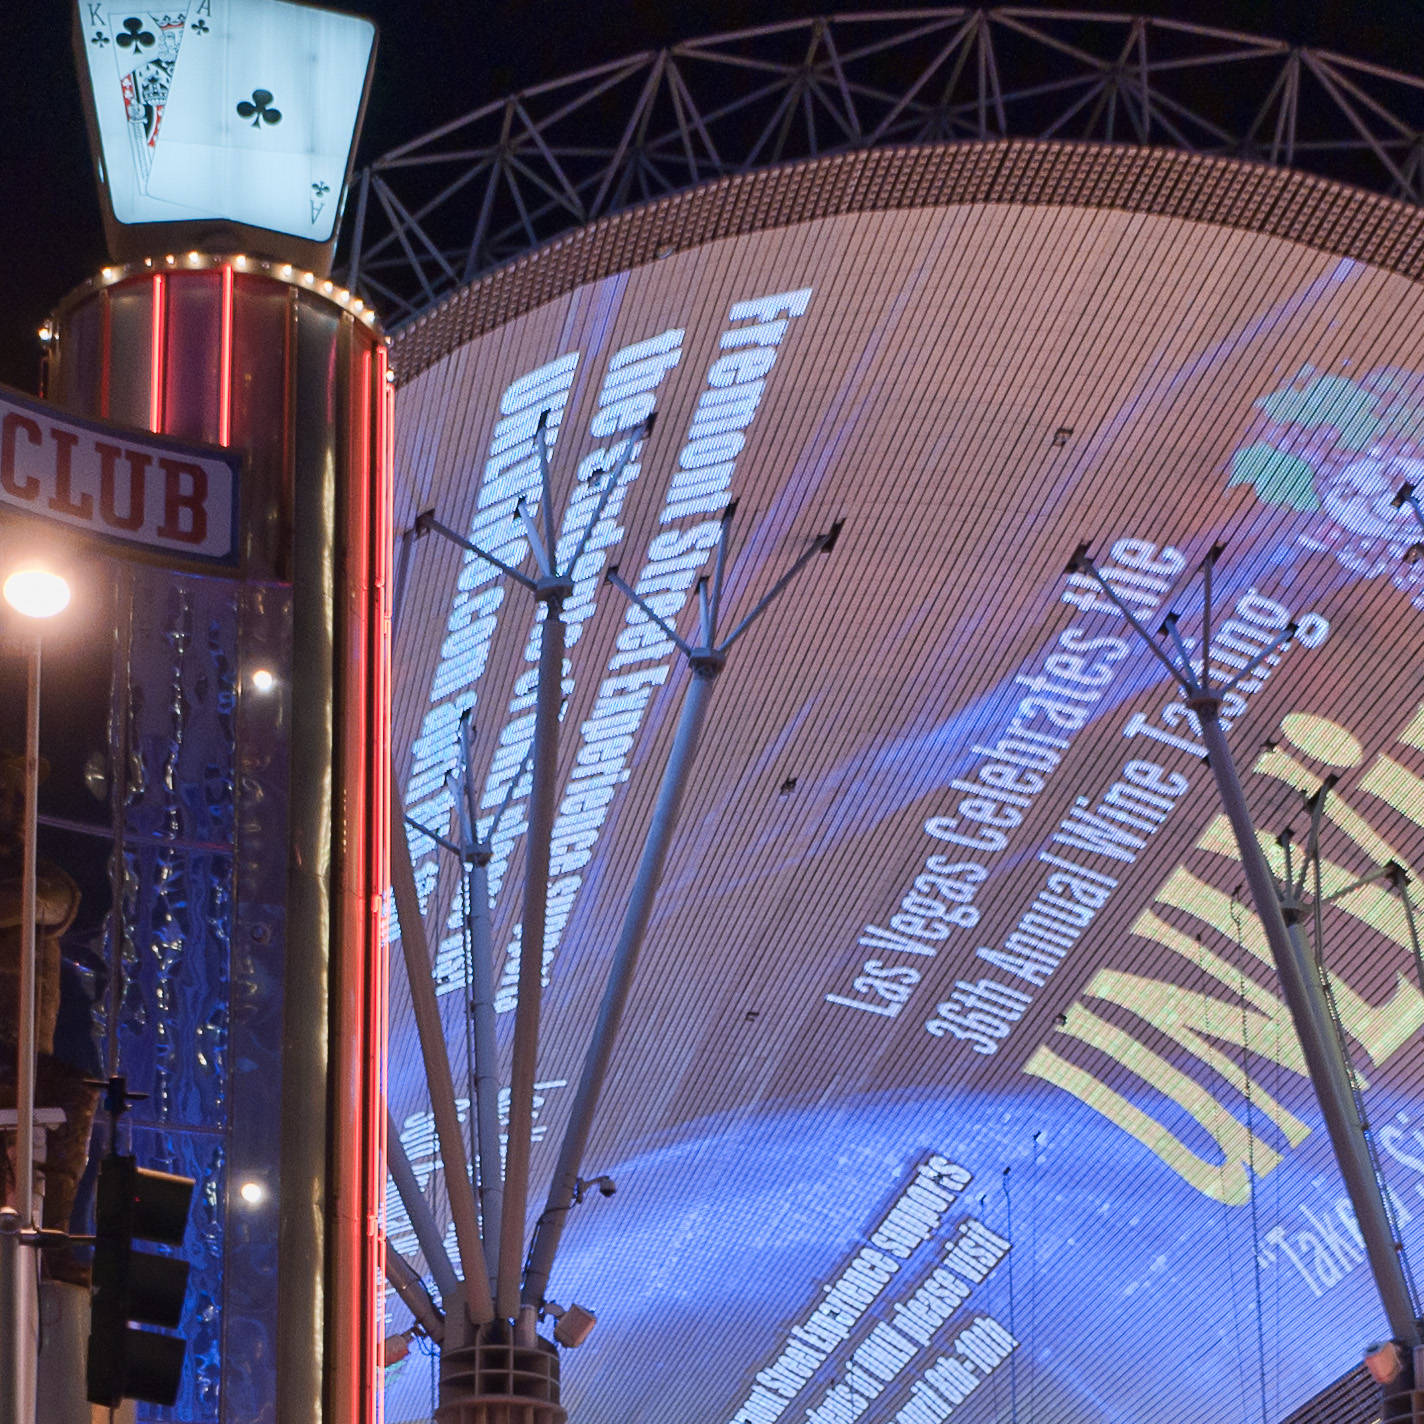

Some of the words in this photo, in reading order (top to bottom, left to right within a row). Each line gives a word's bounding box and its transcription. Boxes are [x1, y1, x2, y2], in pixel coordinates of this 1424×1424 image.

[590, 327, 686, 438] the
[658, 286, 814, 523] Fremont
[0, 411, 209, 546] CLUB
[607, 518, 724, 671] Street
[1060, 538, 1185, 622] the
[549, 664, 670, 877] Experience
[923, 627, 1131, 853] Celebrates
[1051, 758, 1190, 865] Wine
[858, 854, 989, 957] Vegas
[976, 851, 1119, 988] Annual
[824, 960, 921, 1018] Las
[924, 978, 1034, 1056] 36th
[870, 1154, 975, 1259] supports
[791, 1246, 902, 1358] Experience
[894, 1266, 973, 1347] please
[943, 1216, 1013, 1284] visit
[755, 1330, 829, 1400] Street
